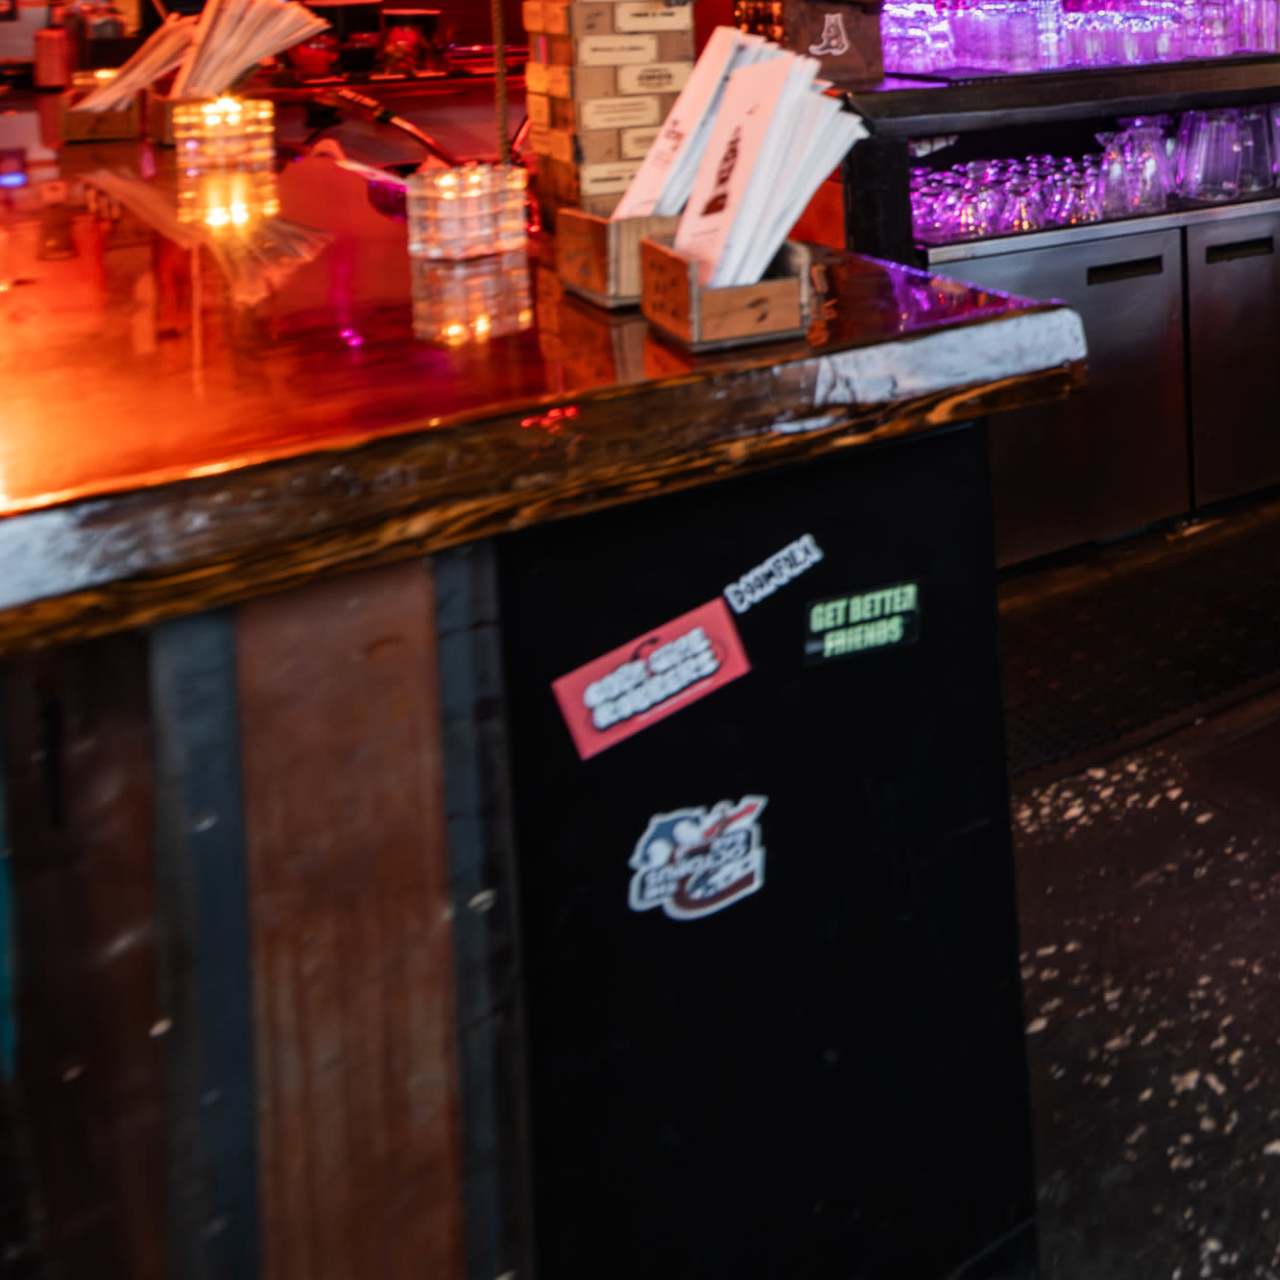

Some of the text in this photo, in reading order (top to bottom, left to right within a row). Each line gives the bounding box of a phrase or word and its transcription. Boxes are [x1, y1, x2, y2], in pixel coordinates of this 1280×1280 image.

[810, 583, 918, 634] GET BETTER
[824, 615, 903, 658] FRIENDS
